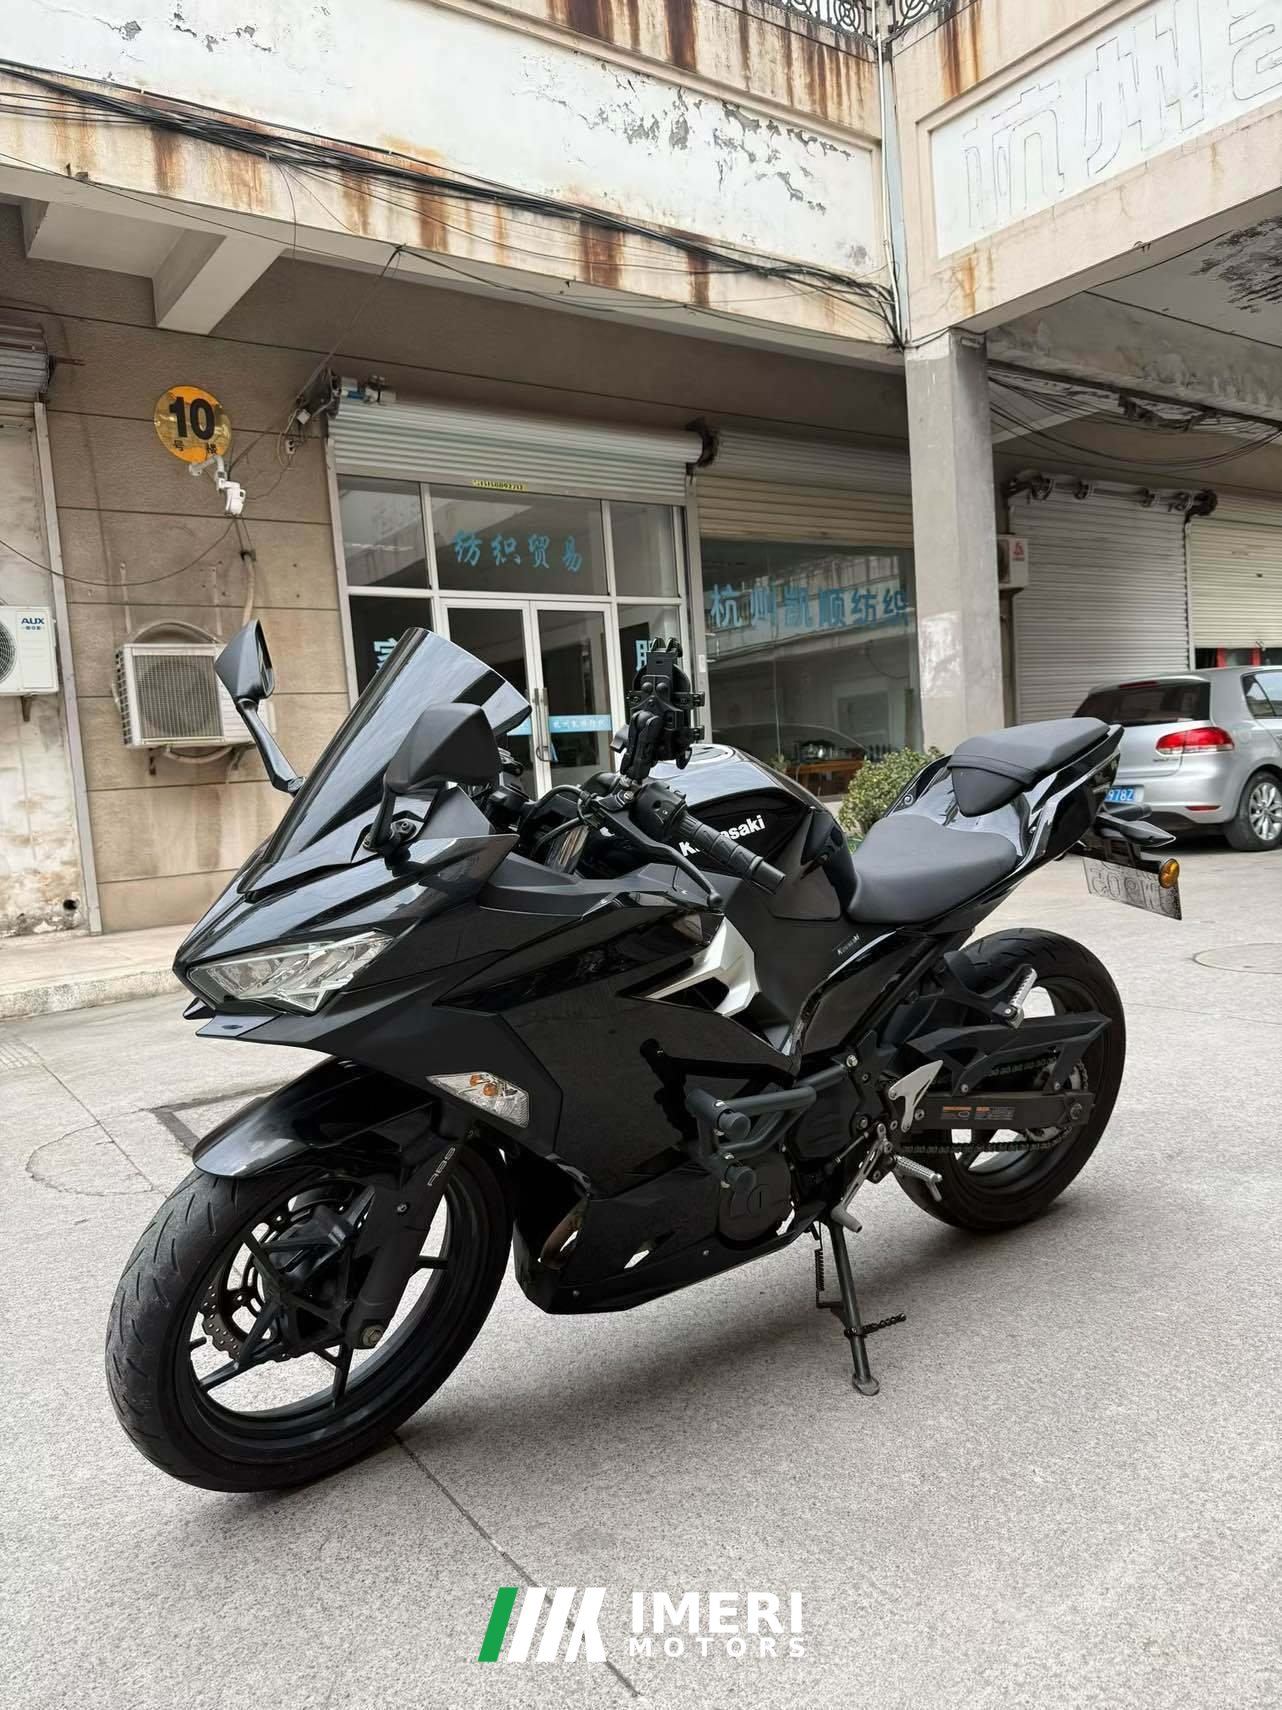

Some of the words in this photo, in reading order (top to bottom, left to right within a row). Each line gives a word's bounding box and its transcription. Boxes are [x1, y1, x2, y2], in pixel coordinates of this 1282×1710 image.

[169, 396, 215, 440] 10
[454, 529, 583, 572] 纺织贸易
[21, 617, 45, 625] AUX
[710, 583, 909, 627] 杭州凯顺纺织
[678, 814, 766, 857] Kasaki
